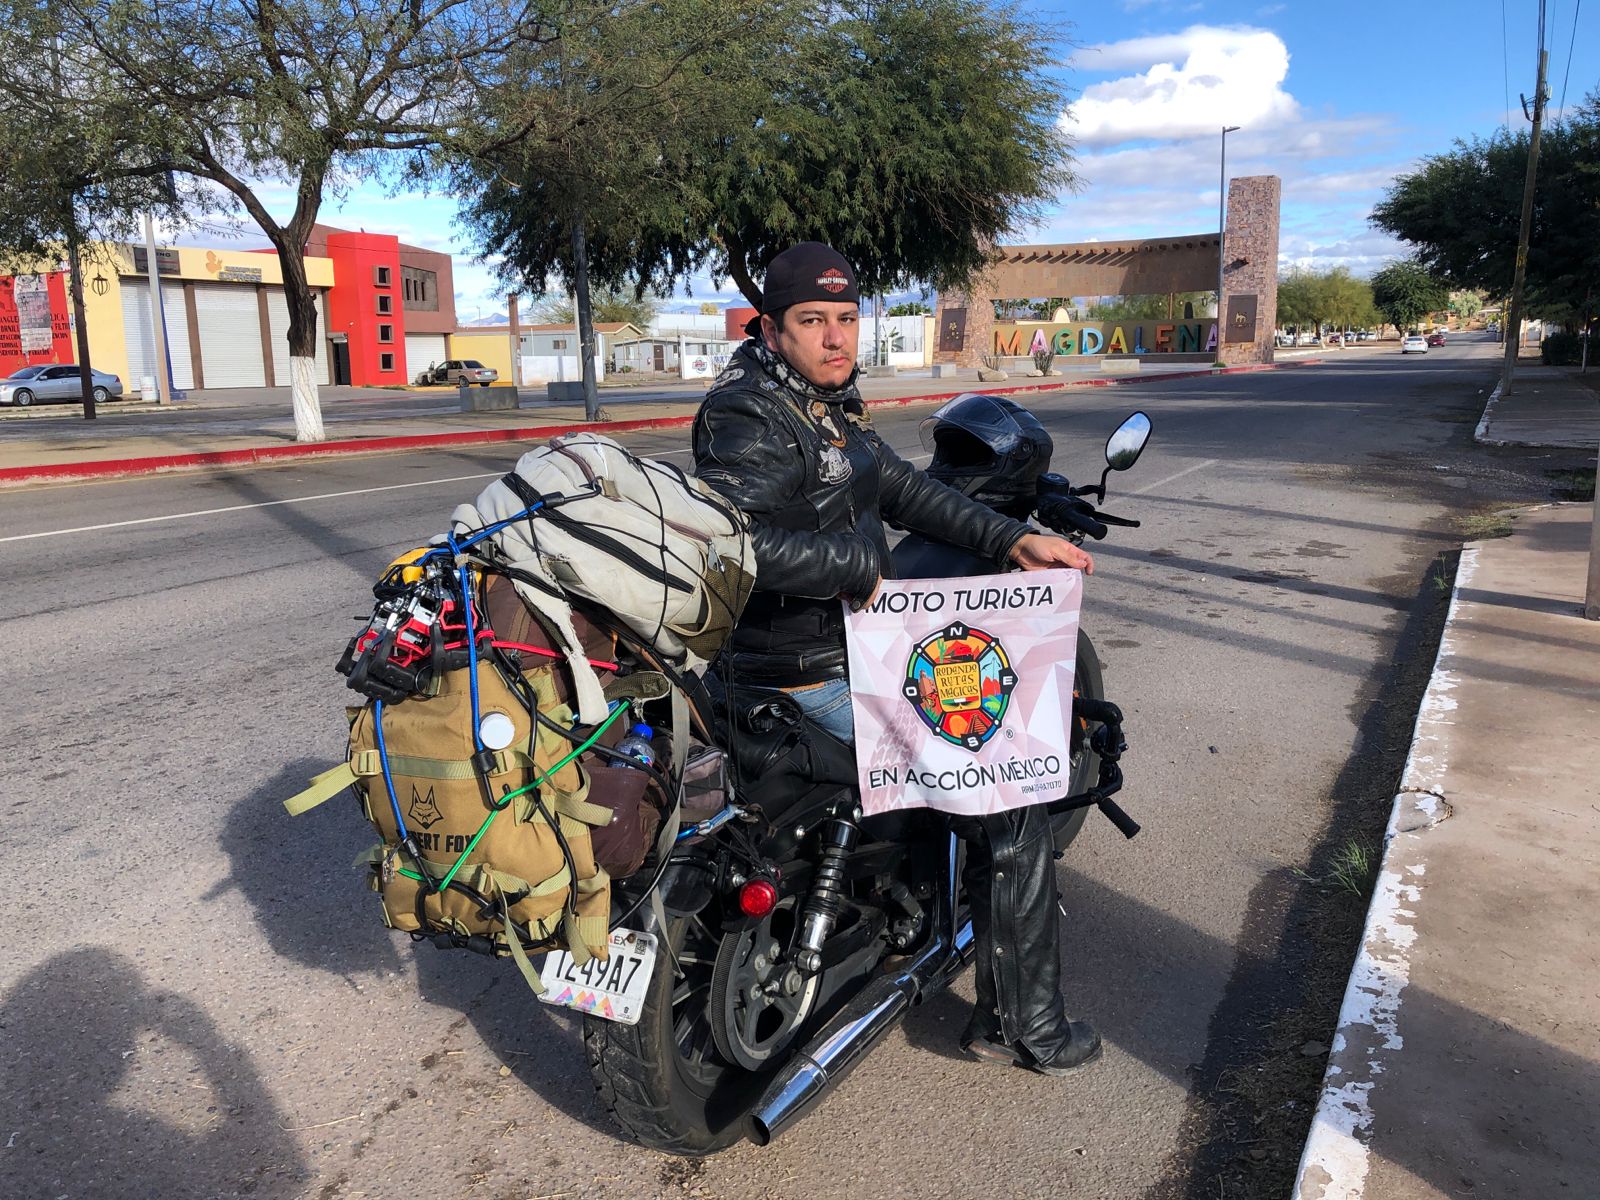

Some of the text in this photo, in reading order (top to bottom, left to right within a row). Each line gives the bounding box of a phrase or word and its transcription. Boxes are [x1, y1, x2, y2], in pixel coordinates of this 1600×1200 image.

[995, 324, 1217, 356] MAGDALENA
[865, 585, 1054, 614] MOTO TURISTA
[950, 626, 963, 636] N
[940, 675, 974, 687] RUTAS
[1003, 675, 1013, 685] E
[906, 687, 918, 696] O
[967, 737, 979, 747] S
[869, 756, 1060, 790] EN ACCIÓN MÉXICO
